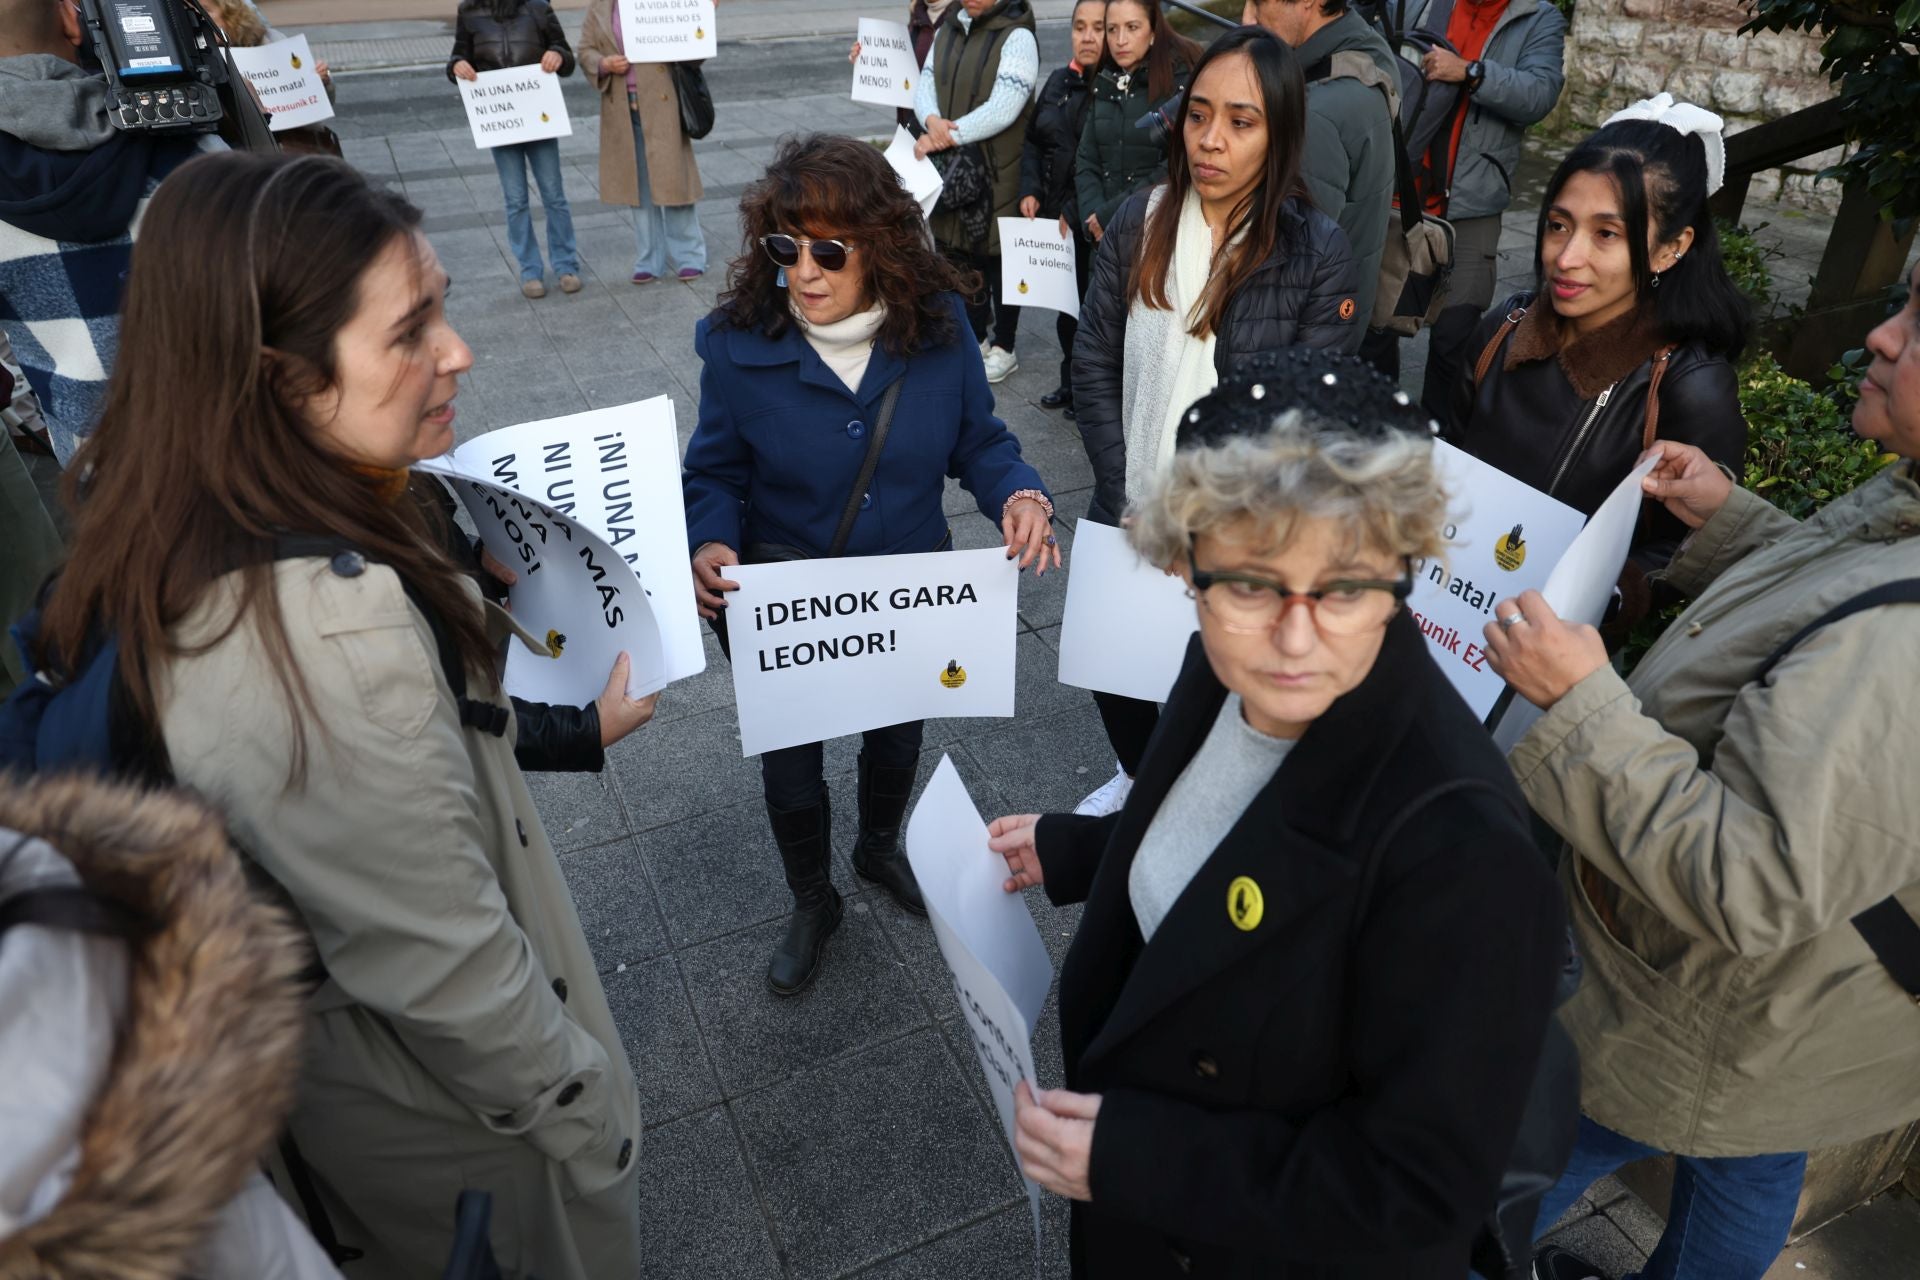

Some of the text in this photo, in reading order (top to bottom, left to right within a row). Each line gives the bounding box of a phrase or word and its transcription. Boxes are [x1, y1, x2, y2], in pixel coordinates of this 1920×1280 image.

[635, 13, 702, 25] MUJERES NO ES
[635, 34, 689, 45] NEGOCIABLE
[874, 36, 890, 49] UNA
[860, 56, 888, 68] NI UNA
[280, 77, 306, 93] mata!
[470, 78, 541, 100] ¡NI UNA MÁS
[860, 75, 892, 88] MENOS!
[308, 94, 318, 105] EZ
[475, 102, 514, 116] NI UNA
[480, 117, 525, 133] MENOS!
[1014, 237, 1065, 252] ¡Actuemos
[1029, 255, 1038, 266] la
[543, 441, 572, 473] NI
[594, 432, 636, 547] ¡NI UNA
[471, 481, 541, 576] ENOS!
[579, 546, 624, 629] MÁS
[754, 583, 978, 631] ¡DENOK GARA
[758, 629, 897, 672] LEONOR!
[1462, 642, 1488, 673] EZ
